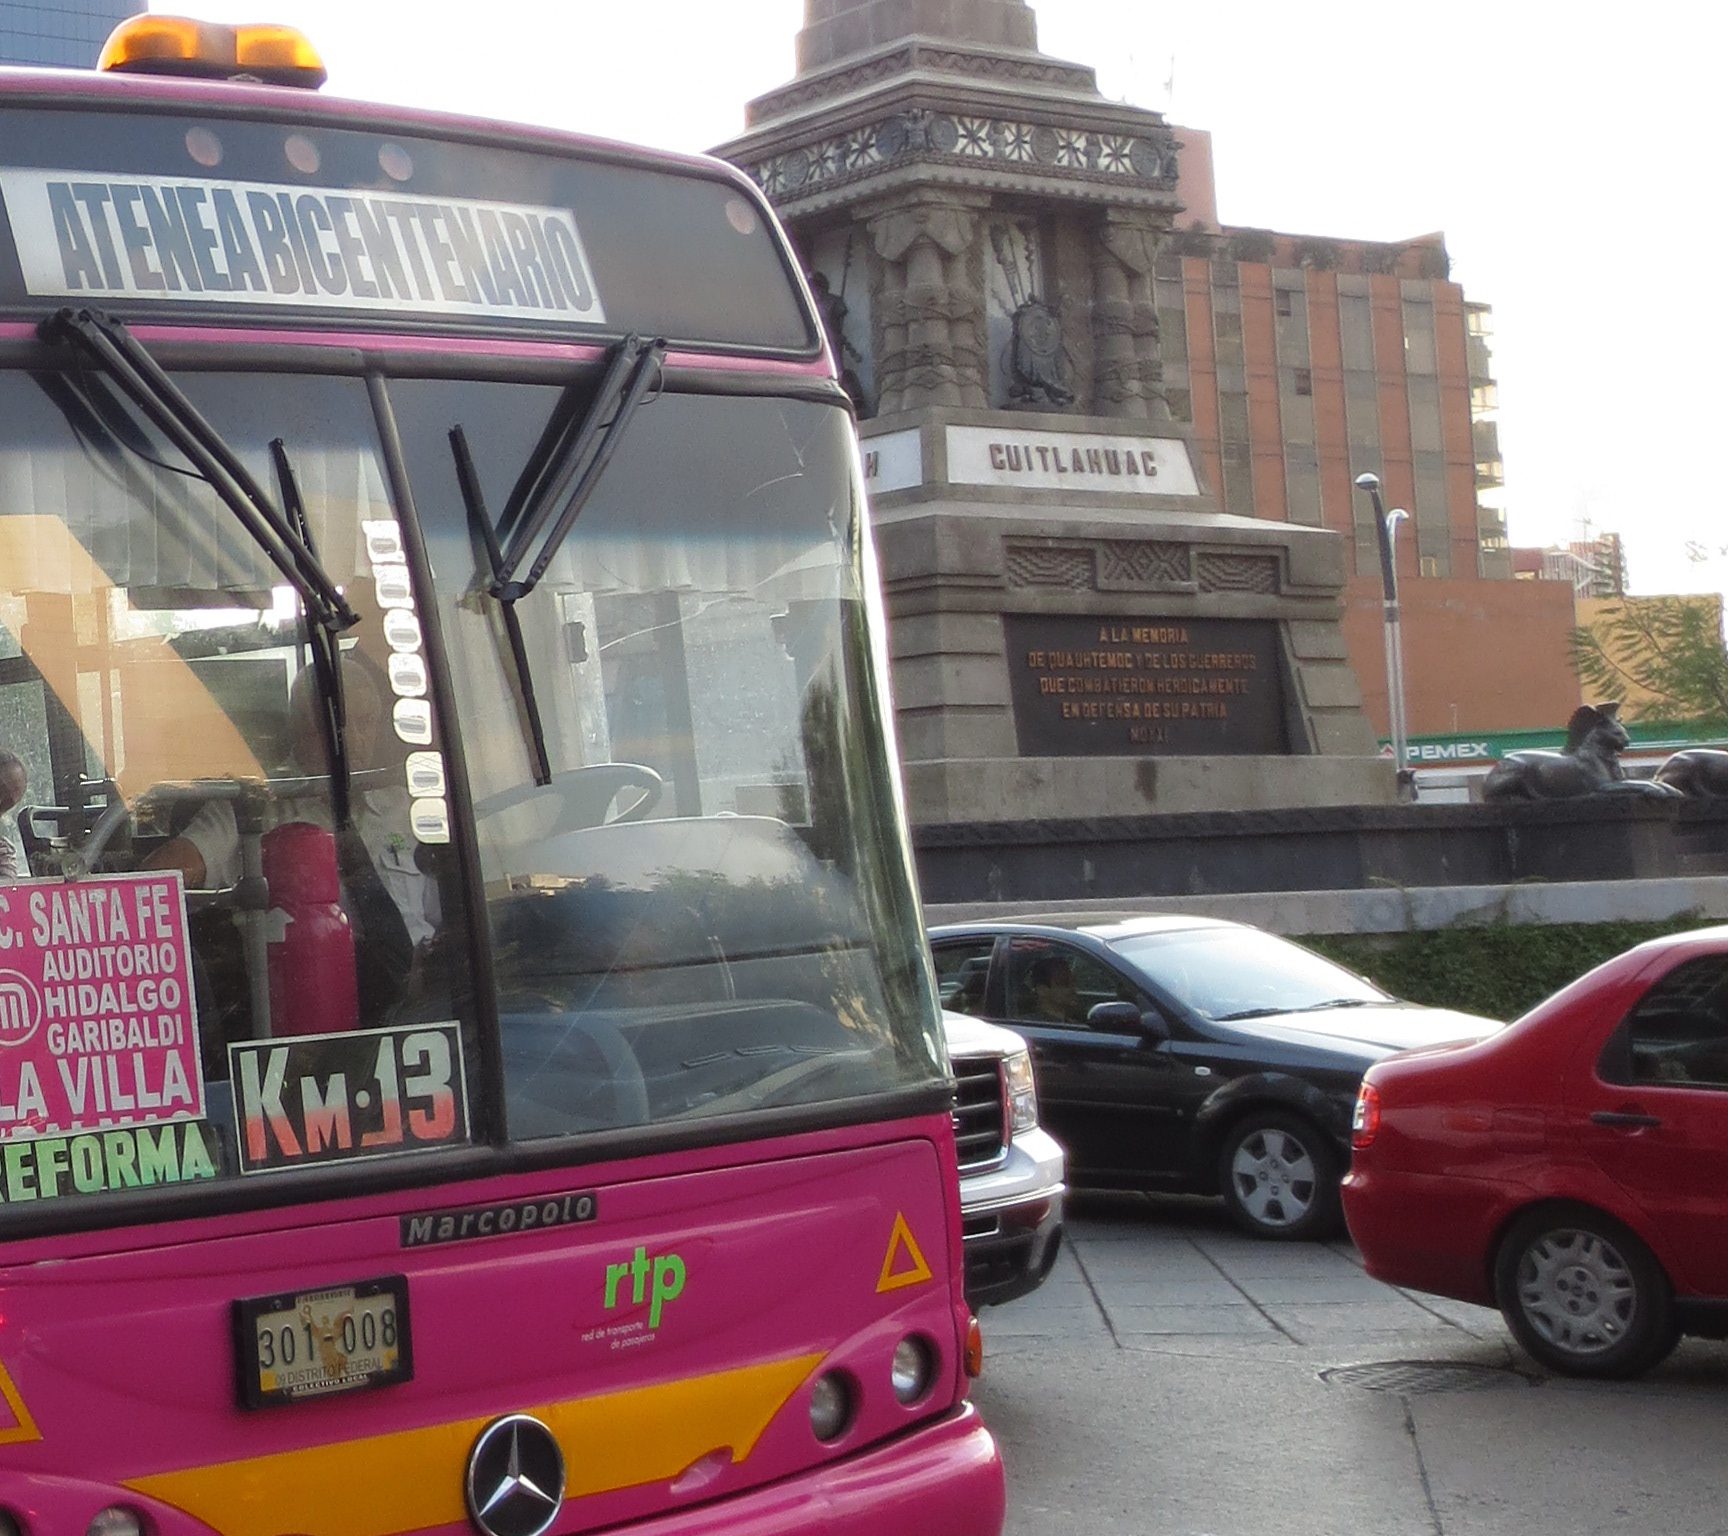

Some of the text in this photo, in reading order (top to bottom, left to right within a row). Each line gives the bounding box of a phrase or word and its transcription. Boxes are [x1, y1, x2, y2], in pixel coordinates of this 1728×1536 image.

[989, 444, 1158, 477] CUITLAHUAC
[1099, 627, 1189, 644] A LA MEMORIA
[1029, 651, 1045, 668] DE
[1144, 652, 1161, 669] DE
[1164, 652, 1187, 669] LOS
[1040, 677, 1249, 696] QUE COMBATIERON HEROICAMENTE
[1062, 702, 1229, 720] EN DEFENSA DE SU PATRIA
[1405, 742, 1488, 760] PEMEX
[29, 887, 130, 948] SANTA
[135, 883, 173, 940] FE
[42, 942, 177, 982] AUDITORIO
[44, 977, 181, 1018] HIDALGO
[47, 1013, 184, 1055] GARIBALDI
[57, 1048, 193, 1115] VILLA
[408, 1196, 594, 1245] Marcopolo
[604, 1246, 687, 1329] rtp
[258, 1309, 397, 1369] 301-008
[580, 1322, 643, 1342] red de transporte
[610, 1333, 655, 1350] de pasajeros
[287, 1365, 337, 1385] DISTRITO
[340, 1358, 382, 1375] FEDERAL
